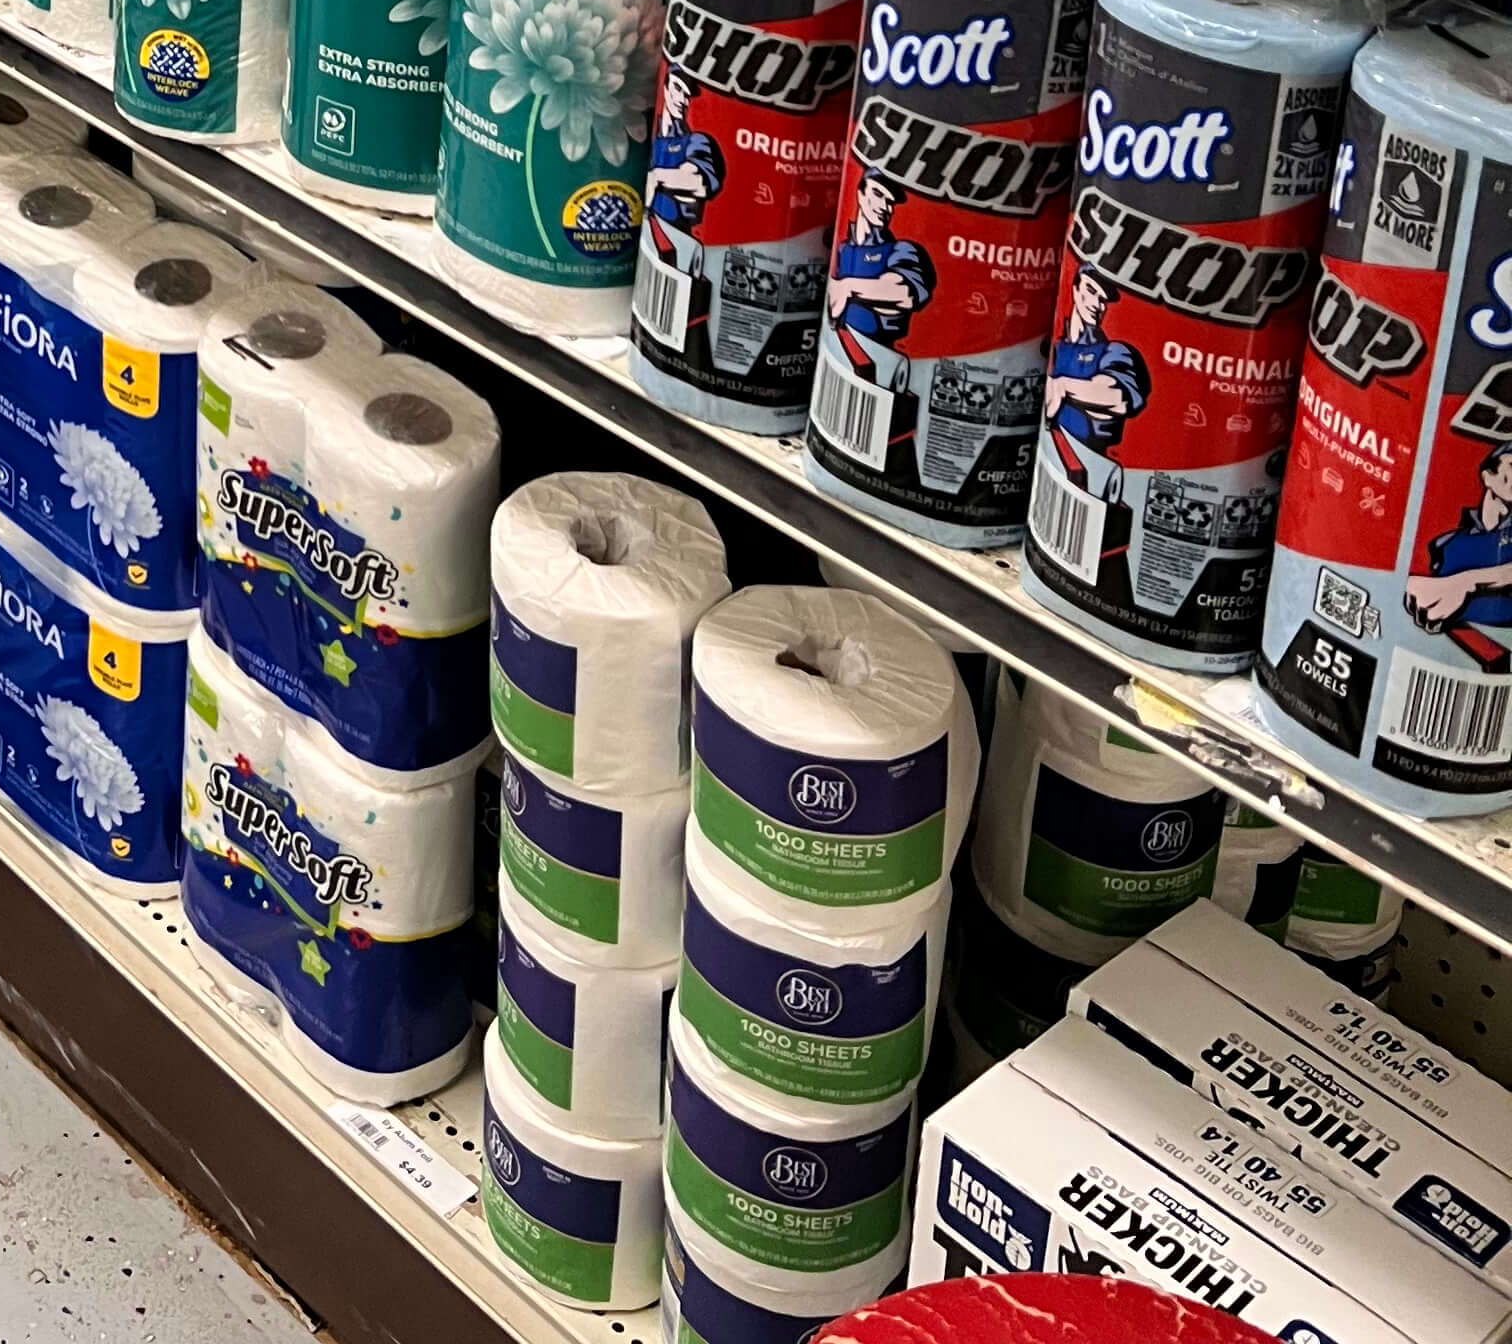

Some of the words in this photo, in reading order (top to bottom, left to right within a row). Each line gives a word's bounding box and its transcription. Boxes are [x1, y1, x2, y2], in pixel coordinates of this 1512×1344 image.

[319, 45, 362, 69] EXTRA
[365, 57, 430, 78] STRONG
[862, 3, 1010, 85] Scott
[1080, 89, 1228, 179] Scott
[852, 96, 1072, 214] SHOP
[1385, 134, 1446, 178] ABSORBS
[1376, 205, 1394, 231] 2X
[1395, 213, 1435, 253] MORE
[1067, 188, 1309, 329] SHOP
[120, 365, 135, 385] 4
[1163, 342, 1294, 380] ORIGINAL
[16, 416, 48, 447] STRONG
[1299, 380, 1397, 464] ORIGINAL
[103, 651, 117, 669] 4
[1295, 654, 1349, 697] TOWELS
[1312, 637, 1353, 679] 55
[797, 774, 845, 807] BEST
[756, 820, 805, 850] 1000
[811, 840, 886, 858] SHEETS
[772, 844, 830, 867] BATHROOM
[740, 1018, 791, 1048] 1000
[797, 1041, 872, 1060] SHEETS
[1334, 1023, 1361, 1043] TIE
[1371, 1029, 1406, 1053] 40
[758, 1041, 816, 1066] BATHROOM
[1228, 1032, 1288, 1077] BAGS
[1364, 1042, 1416, 1080] TWIST
[1416, 1057, 1450, 1084] 55
[1200, 1038, 1392, 1178] THICKER
[1200, 1126, 1240, 1156] 1.4
[399, 1161, 432, 1189] $4.39
[1205, 1151, 1232, 1173] TIE
[1245, 1156, 1282, 1182] 40
[951, 1158, 1014, 1216] Iron-
[1087, 1165, 1149, 1214] BAGS
[1237, 1171, 1290, 1214] TWIST
[1291, 1184, 1327, 1214] 55
[727, 1192, 777, 1223] 1000
[783, 1212, 854, 1231] SHEETS
[948, 1180, 1006, 1243] Hold
[1059, 1171, 1255, 1316] THICKER
[1152, 1211, 1268, 1295] CLEAN-UP
